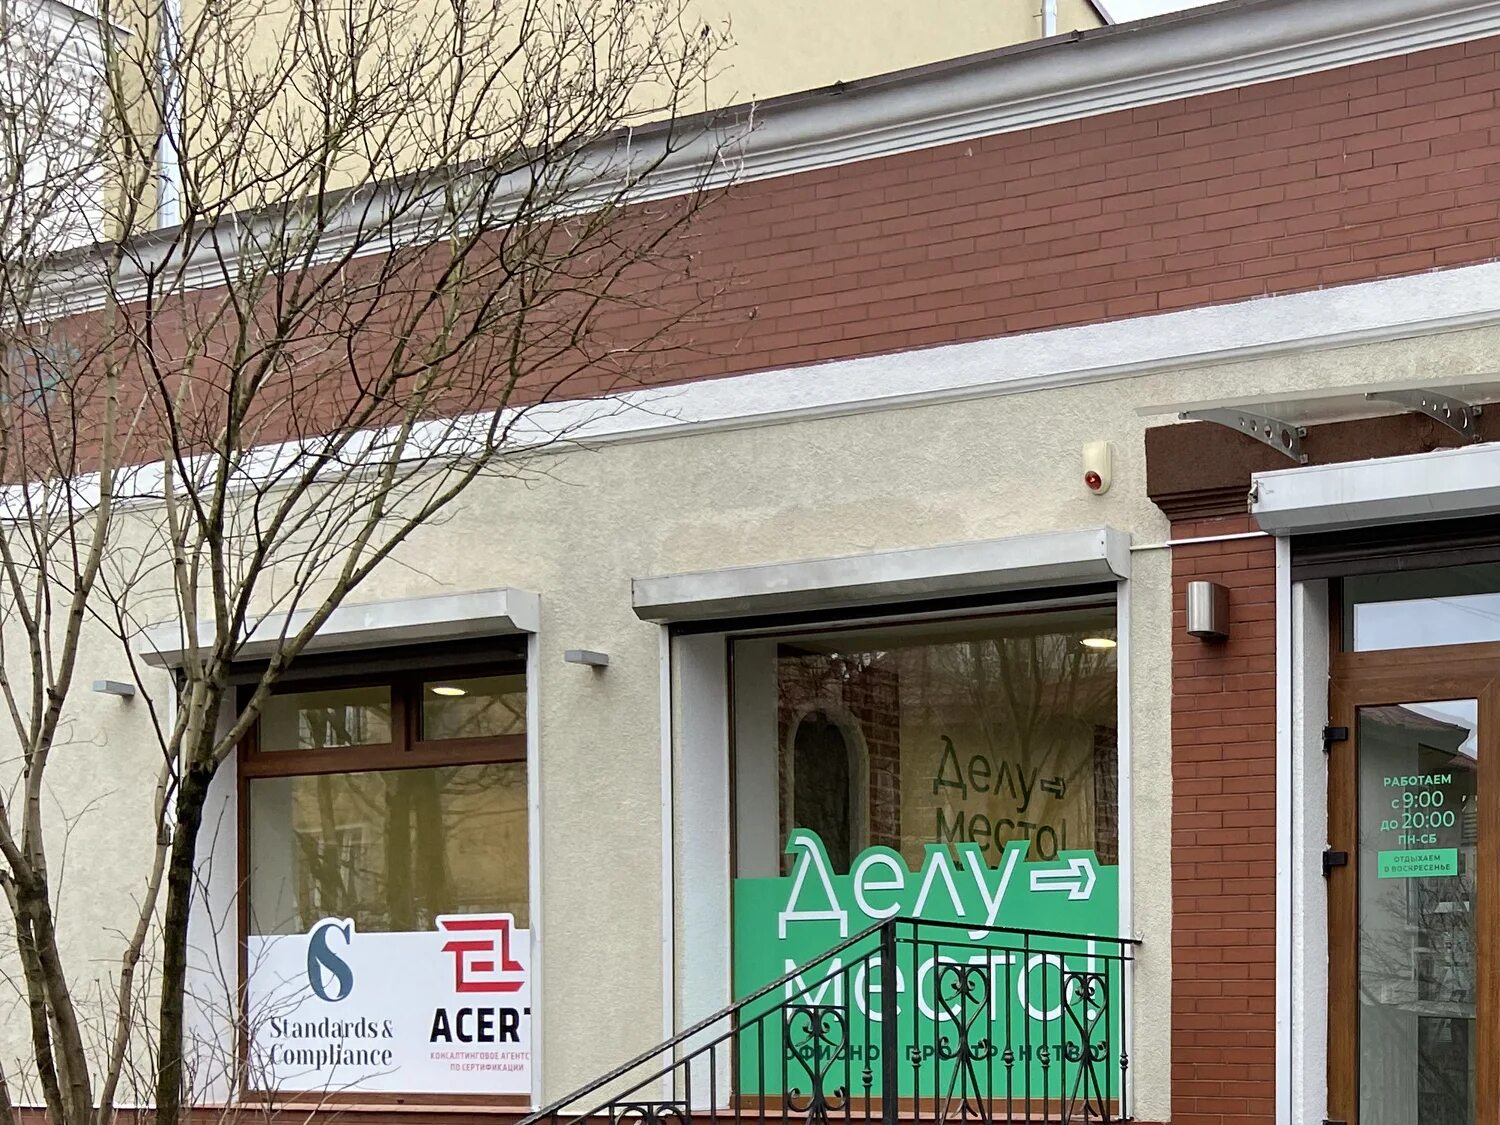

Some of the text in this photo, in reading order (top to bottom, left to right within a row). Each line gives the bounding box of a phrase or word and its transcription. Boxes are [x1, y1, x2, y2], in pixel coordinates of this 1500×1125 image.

[933, 734, 1038, 813] Делу
[1383, 774, 1452, 787] РАБОТАЕМ
[1402, 791, 1444, 809] 9:00
[1401, 810, 1455, 829] 20:00
[1398, 833, 1437, 845] ПН-СБ
[1393, 854, 1441, 863] ОТДЫХАЕМ
[1391, 863, 1451, 872] ВОСКРЕСЕНЬЕ
[778, 836, 1020, 940] Делу
[270, 1016, 393, 1039] Standards &
[270, 1043, 393, 1070] Compliance
[430, 1051, 499, 1060] КОНСАЛТИНГОВОЕ
[450, 1063, 524, 1072] ПО СЕРТИФИКАЦИИ
